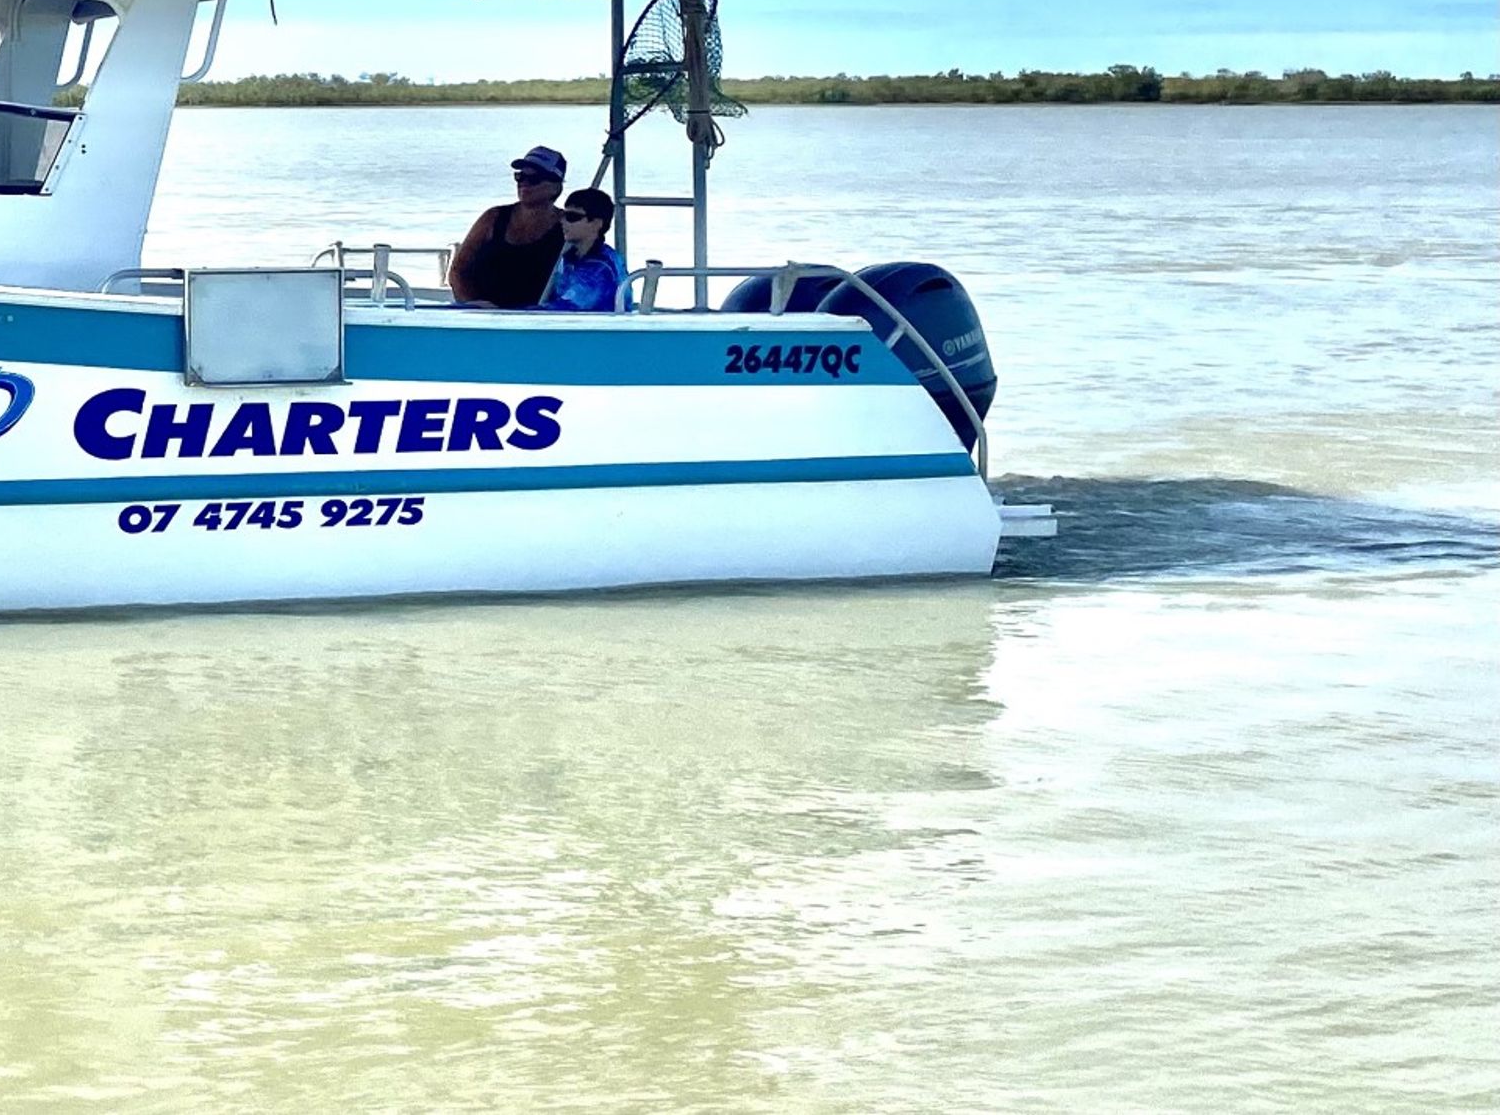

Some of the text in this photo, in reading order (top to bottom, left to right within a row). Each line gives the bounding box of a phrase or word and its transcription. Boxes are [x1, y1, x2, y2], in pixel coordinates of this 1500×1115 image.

[724, 344, 862, 378] 26447QC
[73, 387, 565, 461] CHARTERS
[117, 496, 425, 534] 07 4745 9275
